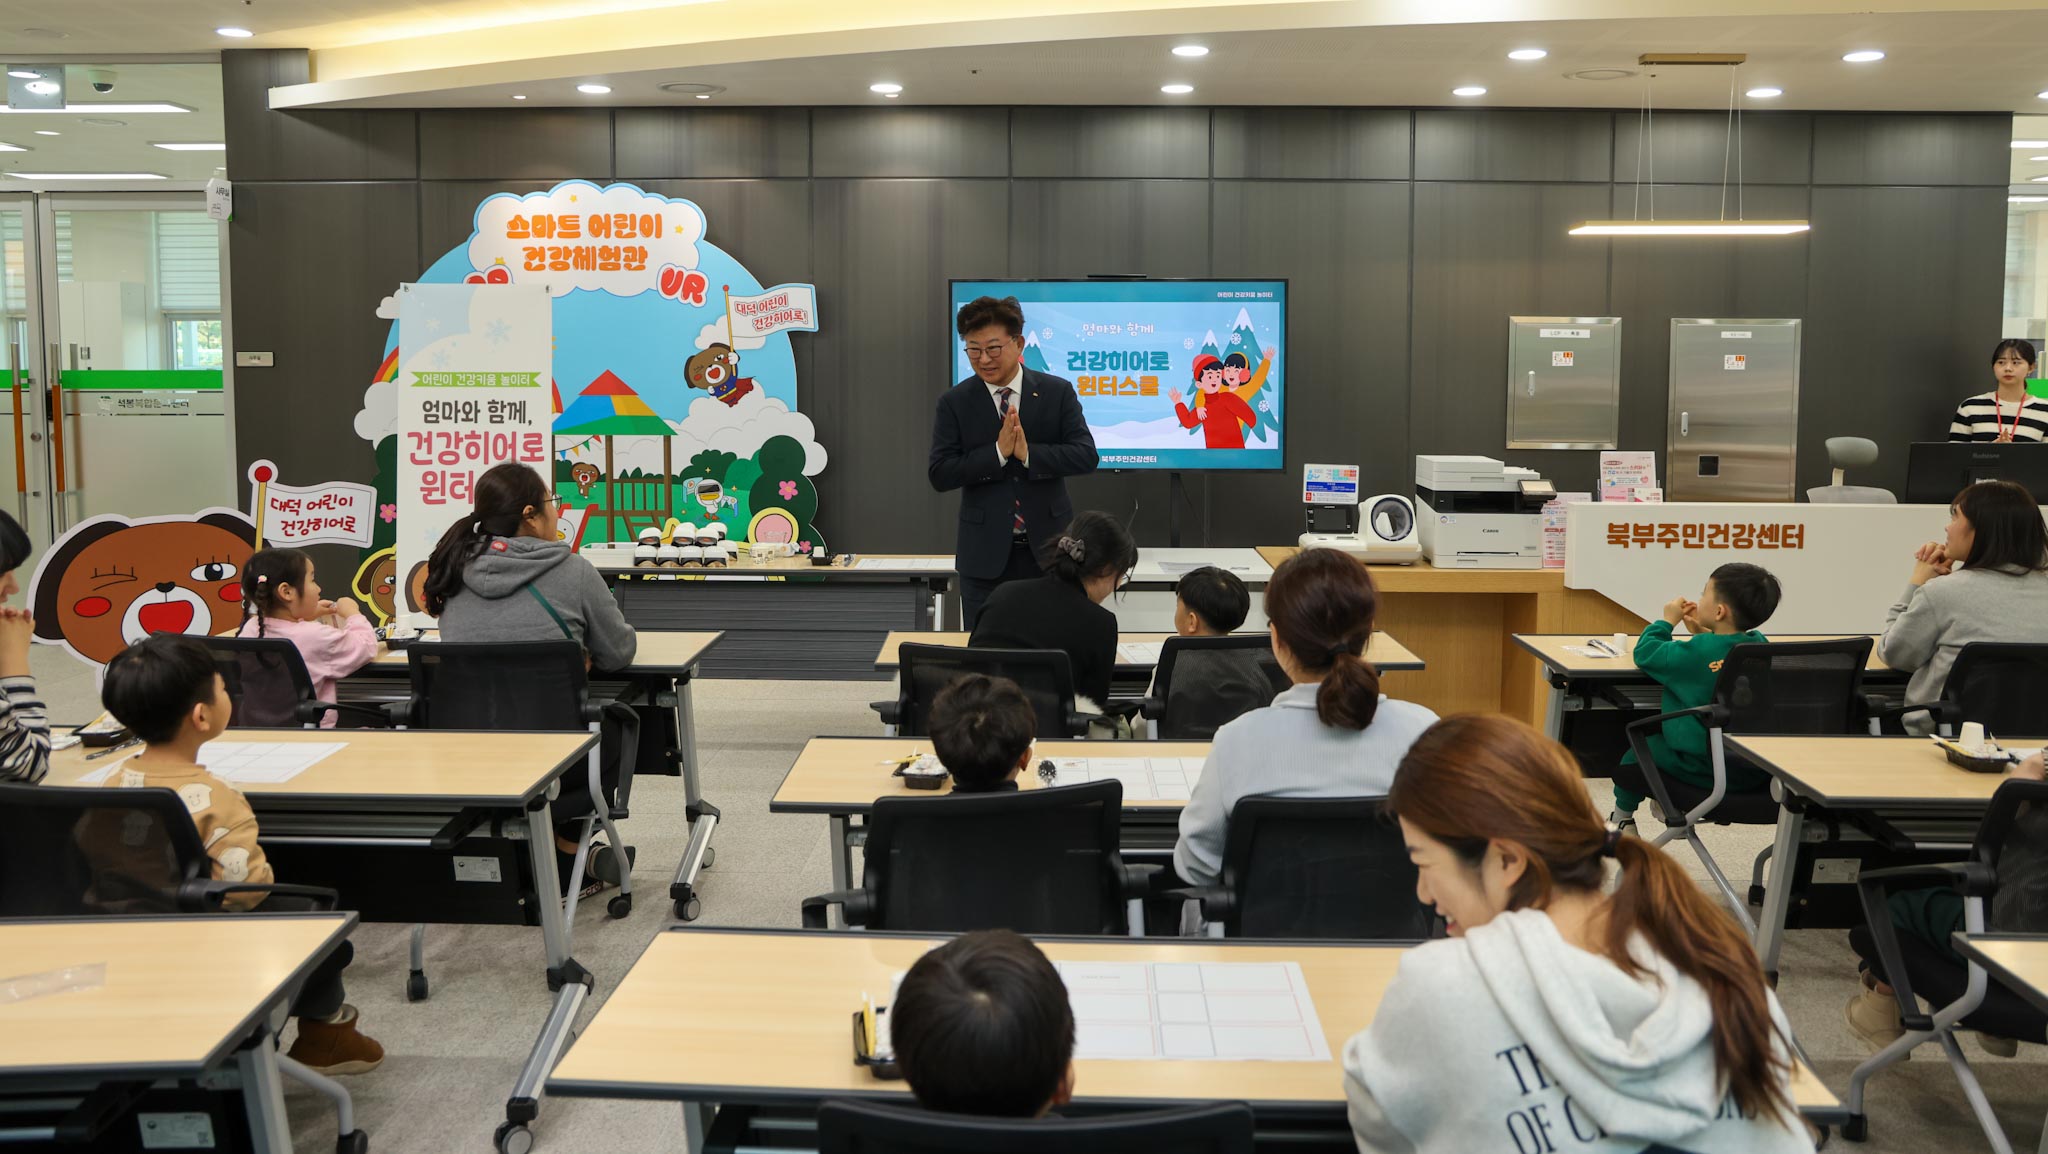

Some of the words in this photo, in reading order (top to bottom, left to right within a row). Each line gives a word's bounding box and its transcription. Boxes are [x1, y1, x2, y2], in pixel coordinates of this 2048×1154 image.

[506, 214, 581, 239] 스마트
[588, 213, 662, 239] 어린이
[522, 245, 648, 271] 건강체험관
[736, 303, 756, 315] 대덕
[759, 294, 787, 312] 어린이
[753, 309, 808, 330] 건강히어로!
[1067, 350, 1170, 371] 건강히어로
[422, 373, 453, 385] 어린이
[456, 373, 496, 386] 건강키움
[500, 373, 530, 386] 놀이터
[422, 400, 481, 424] 엄마와
[487, 399, 533, 426] 함께,
[407, 430, 545, 466] 건강히어로
[1101, 455, 1157, 463] 북부주민건강센터
[270, 497, 302, 516] 대덕
[306, 494, 354, 511] 어린이
[280, 515, 356, 537] 건강히어로
[1606, 522, 1805, 550] 북부주민건강센터
[1506, 1103, 1557, 1154] OF
